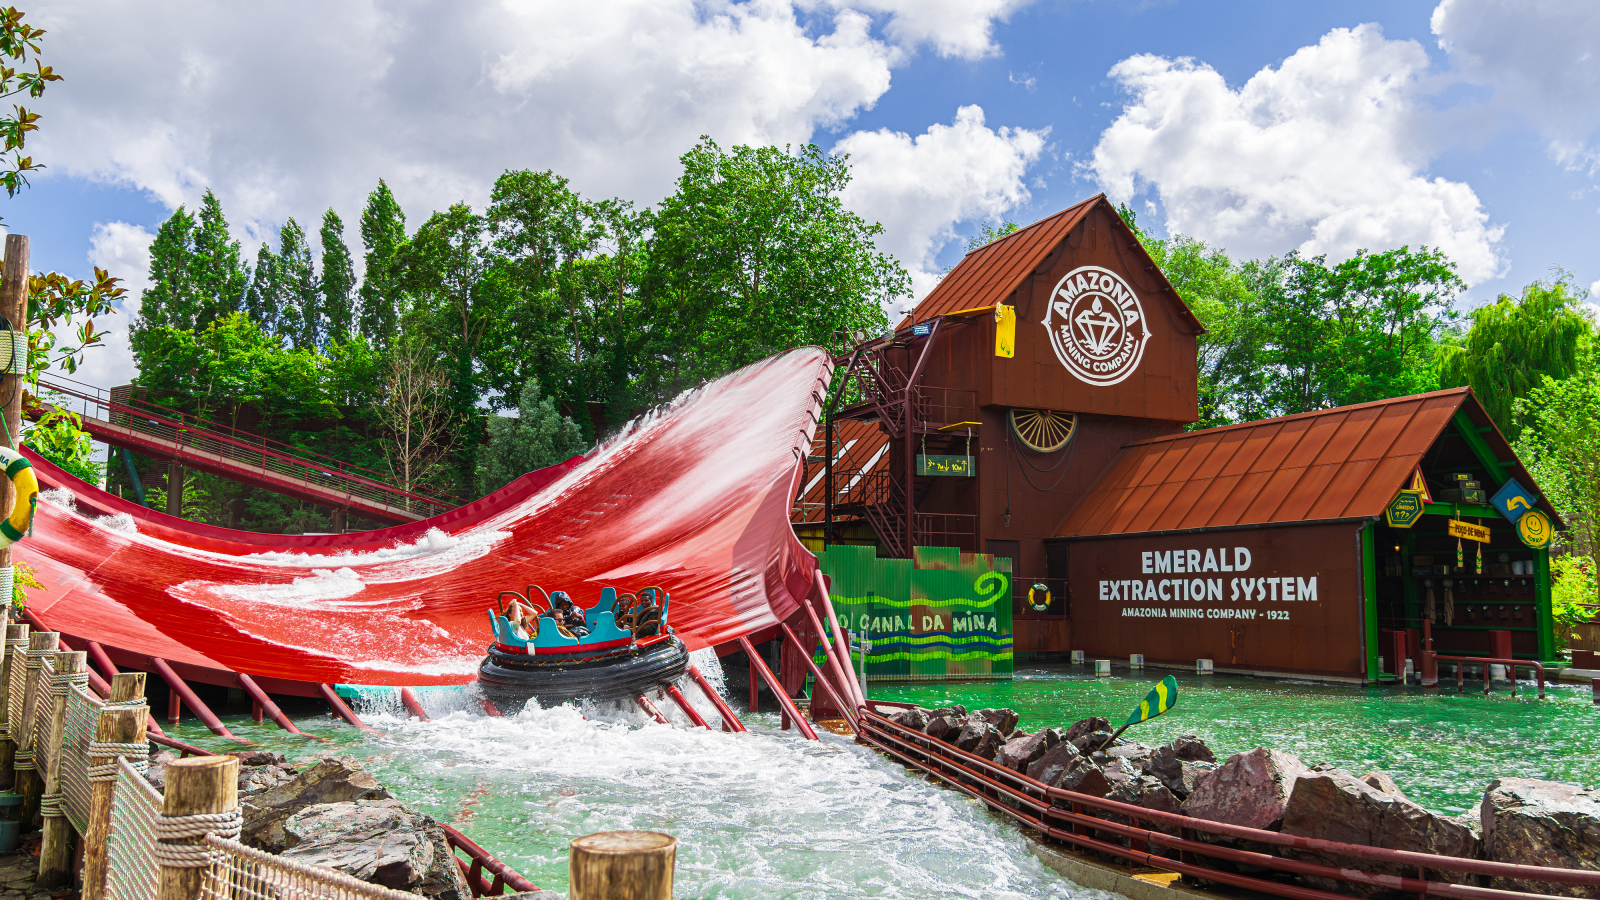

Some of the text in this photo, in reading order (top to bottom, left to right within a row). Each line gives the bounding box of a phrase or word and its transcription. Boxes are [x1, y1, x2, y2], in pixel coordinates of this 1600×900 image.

[1053, 272, 1140, 327] AMAZONIA
[1060, 325, 1135, 372] MINING COMPANY
[1142, 547, 1252, 574] EMERALD
[1099, 576, 1318, 601] EXTRACTION SYSTEM
[859, 614, 915, 633] CANAL
[922, 614, 945, 631] DA
[1121, 608, 1167, 618] AMAZONIA
[1169, 608, 1204, 619] MINING
[1207, 609, 1256, 620] COMPANY
[1266, 610, 1290, 620] 1922
